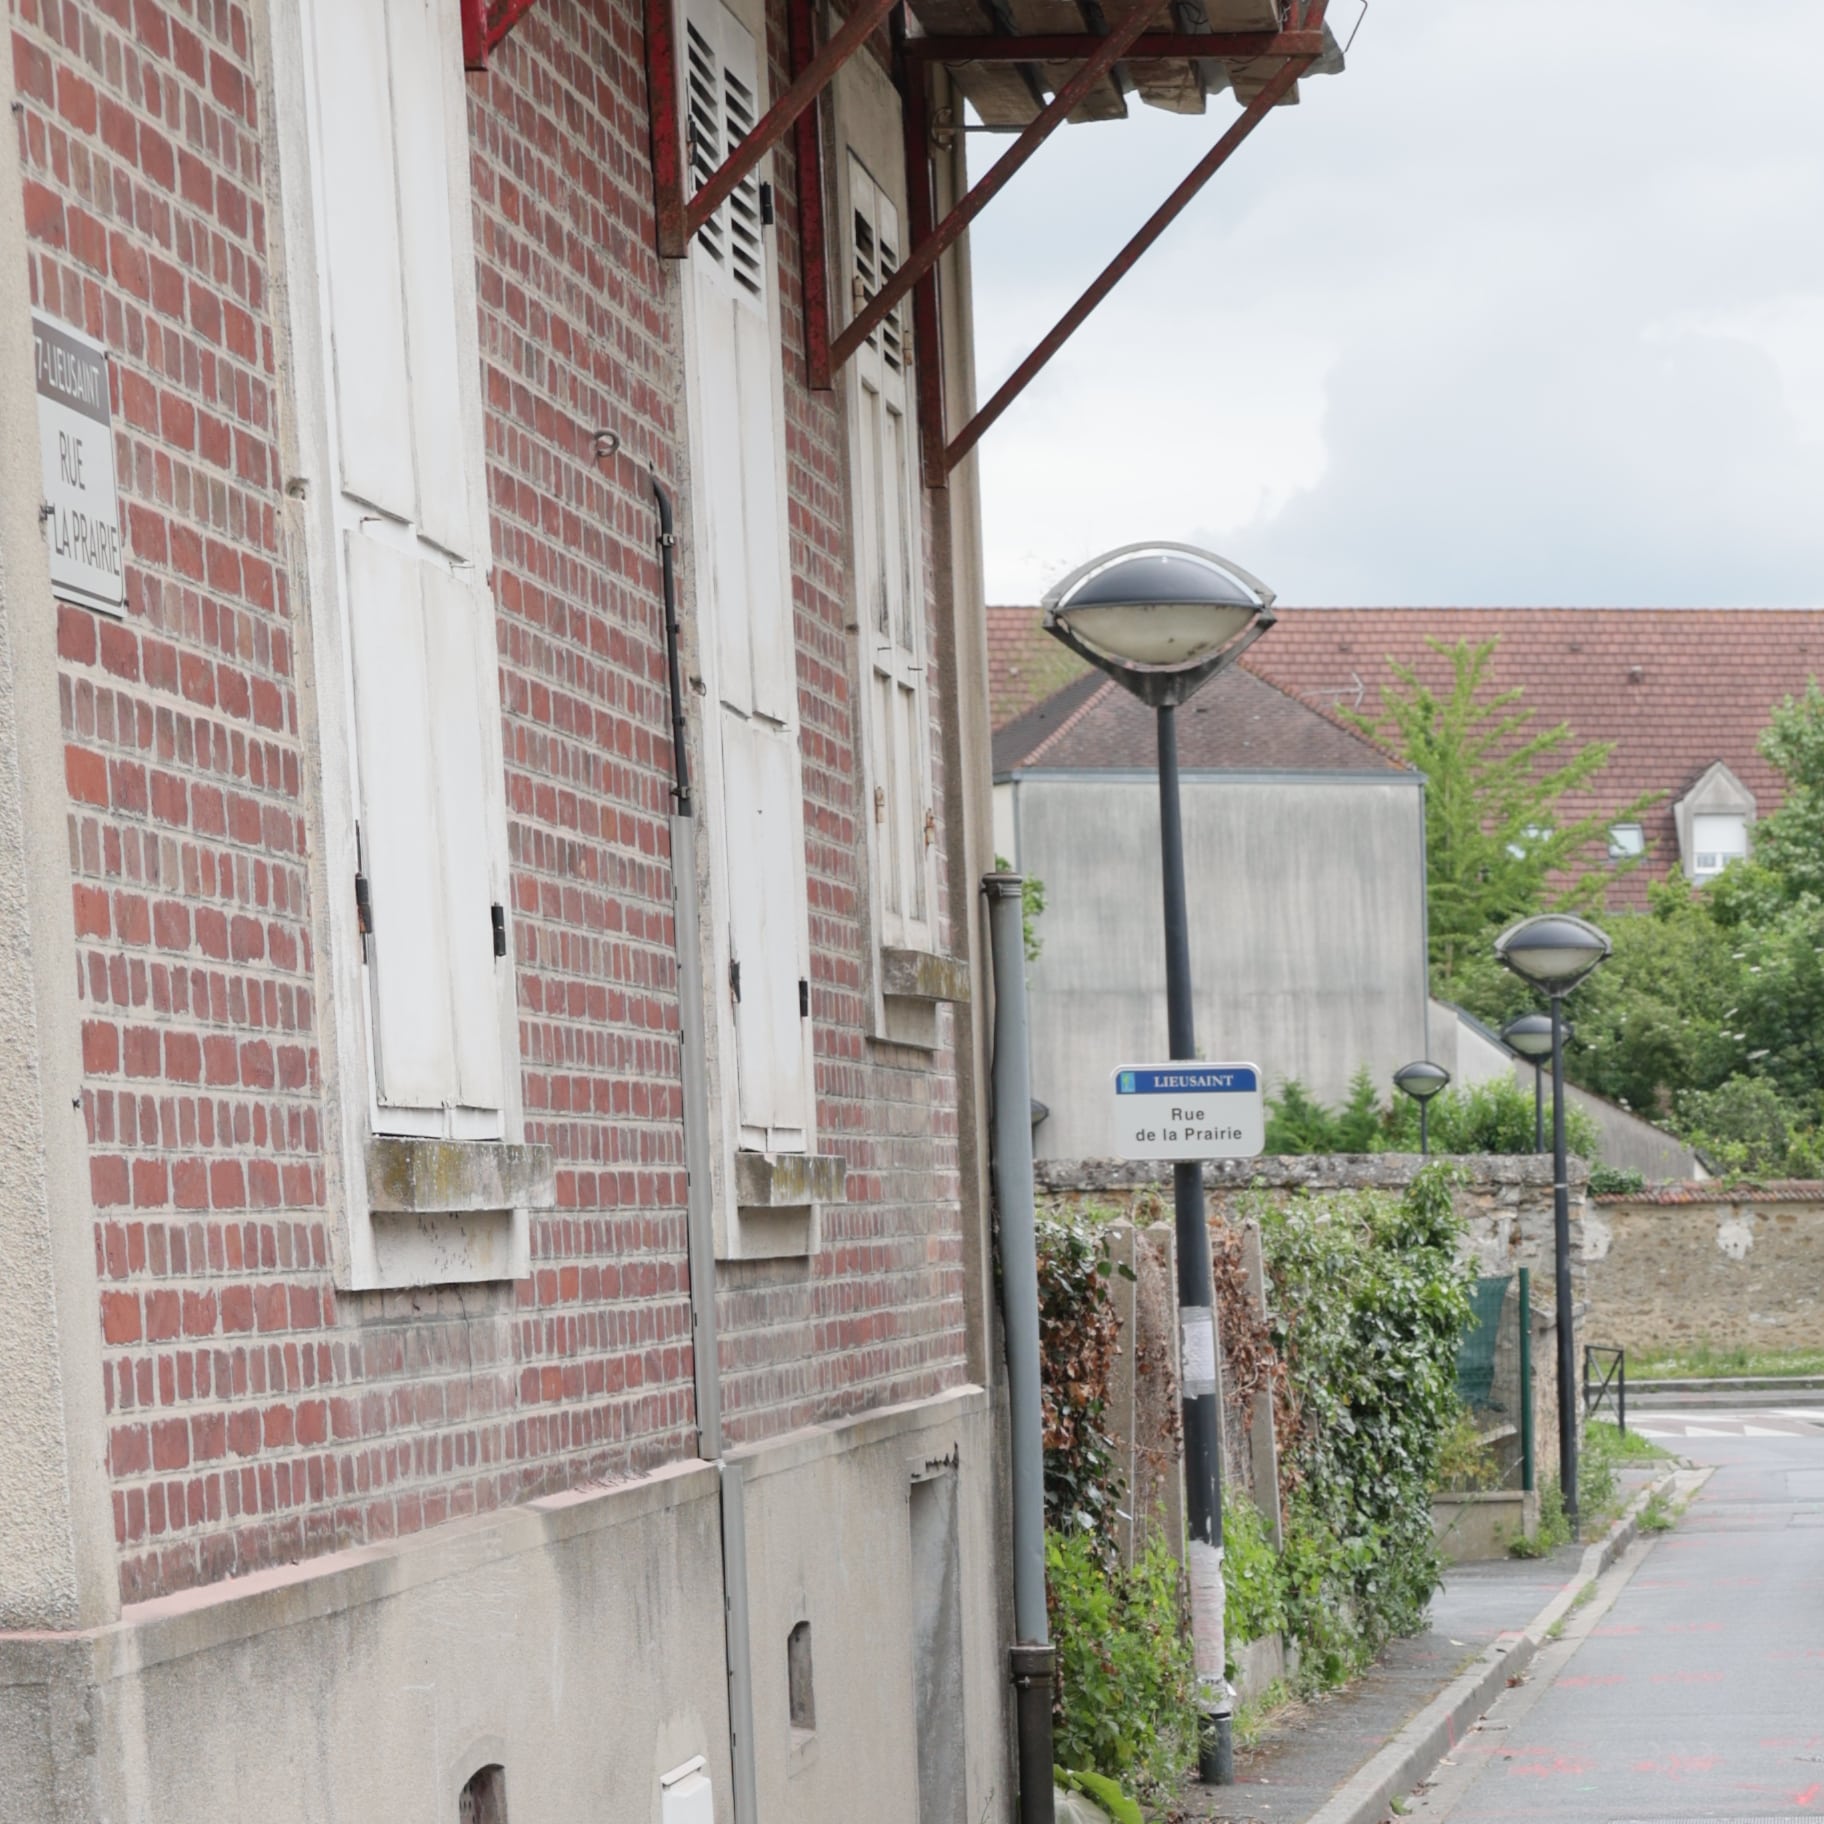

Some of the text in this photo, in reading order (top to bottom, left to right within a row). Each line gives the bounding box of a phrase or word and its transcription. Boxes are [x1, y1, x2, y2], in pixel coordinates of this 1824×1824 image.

[59, 429, 86, 491] RUE
[53, 503, 121, 577] LA PRAIRIE
[1153, 1074, 1234, 1088] LIEUSAINT
[1171, 1107, 1205, 1121] Rue
[1135, 1126, 1243, 1142] de la Prairie
